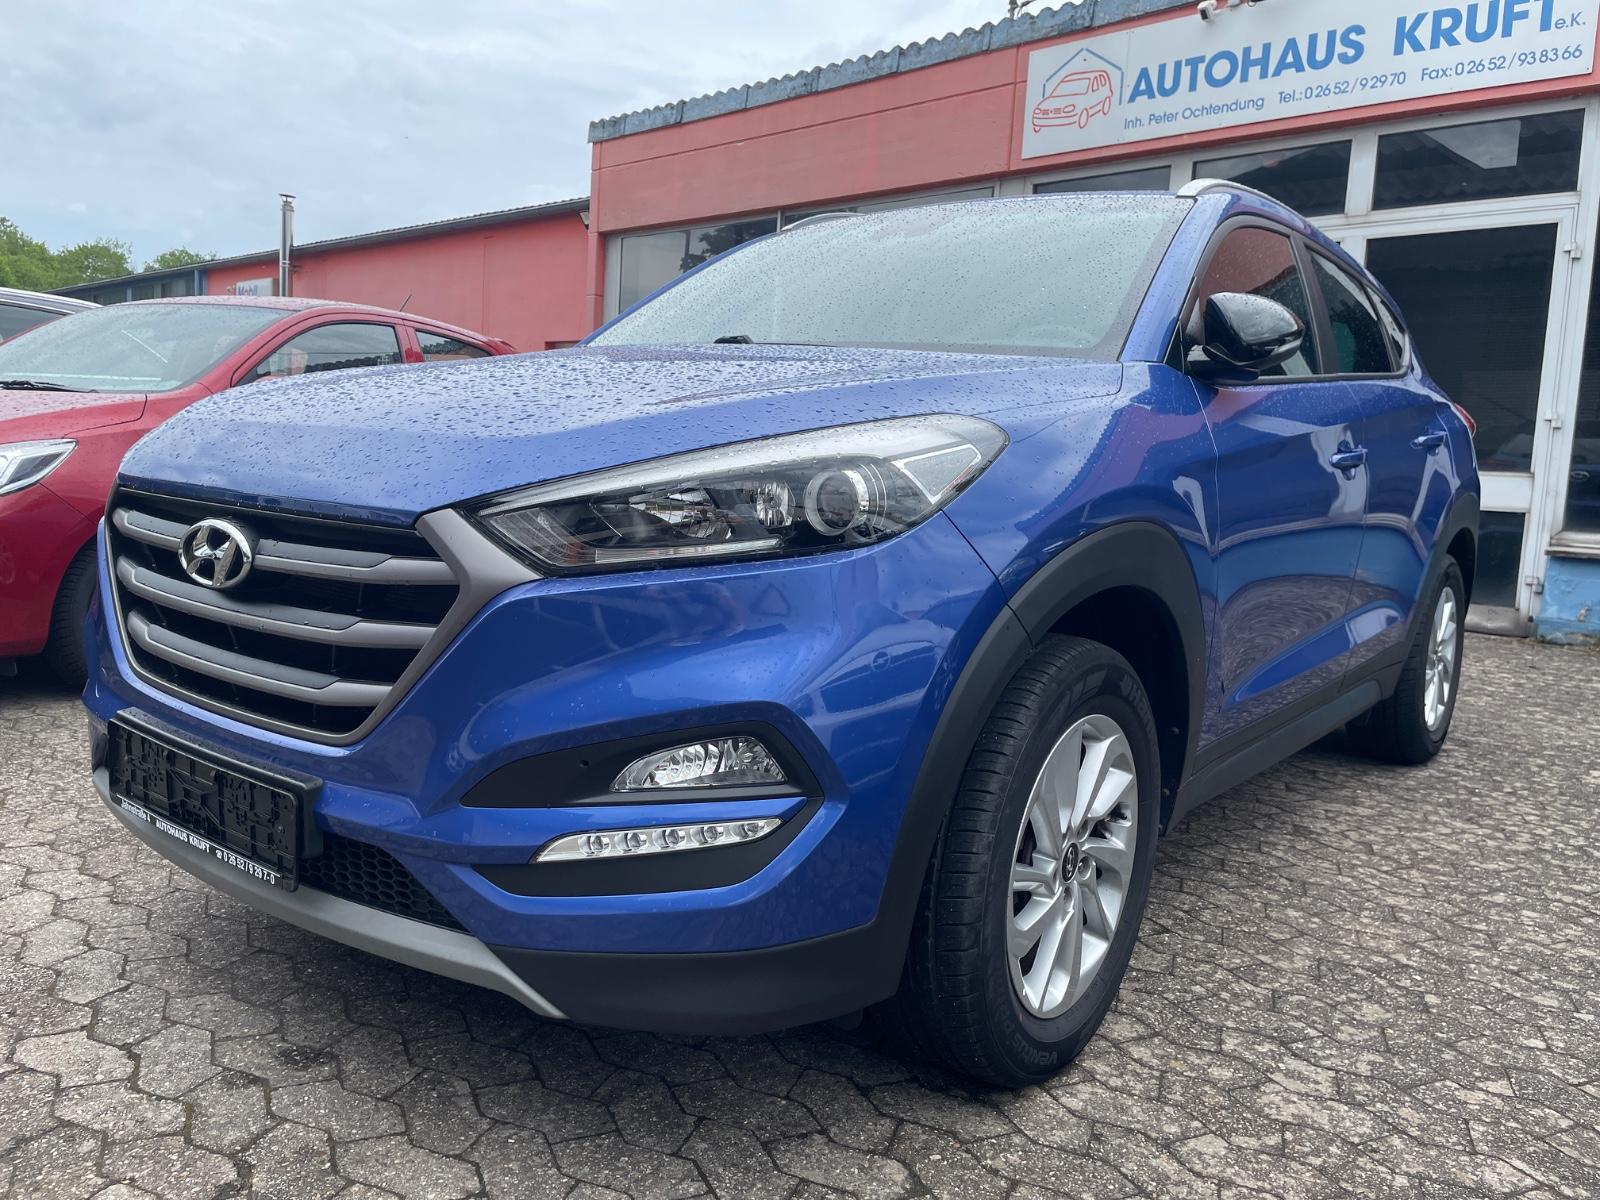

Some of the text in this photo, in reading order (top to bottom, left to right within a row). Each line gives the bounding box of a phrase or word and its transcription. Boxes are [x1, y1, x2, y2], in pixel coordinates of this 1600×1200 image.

[1127, 0, 1587, 104] AUTOHAUS KRUFT e.K.
[1123, 116, 1146, 130] Inh.
[1148, 112, 1179, 127] Peter
[1181, 97, 1265, 121] Ochtendung
[155, 819, 188, 843] AUTOHAUS
[188, 835, 210, 853] KRUFT
